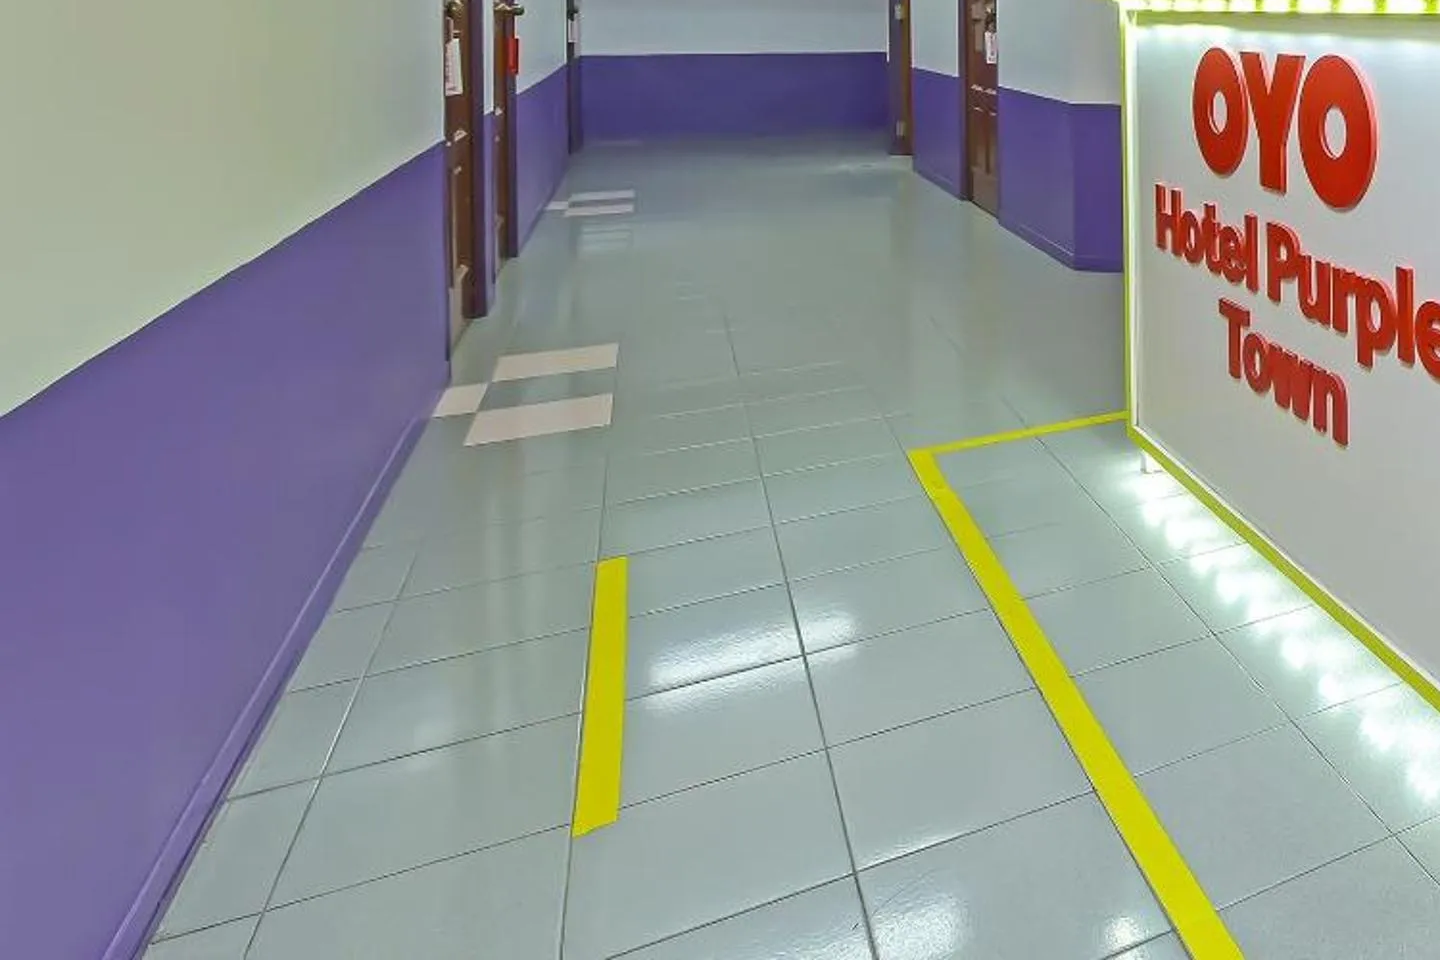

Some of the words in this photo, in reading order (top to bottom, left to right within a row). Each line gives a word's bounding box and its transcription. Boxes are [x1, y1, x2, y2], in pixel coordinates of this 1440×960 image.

[1192, 46, 1378, 212] OYO
[1155, 183, 1259, 294] Hotel
[1218, 297, 1349, 448] Town
